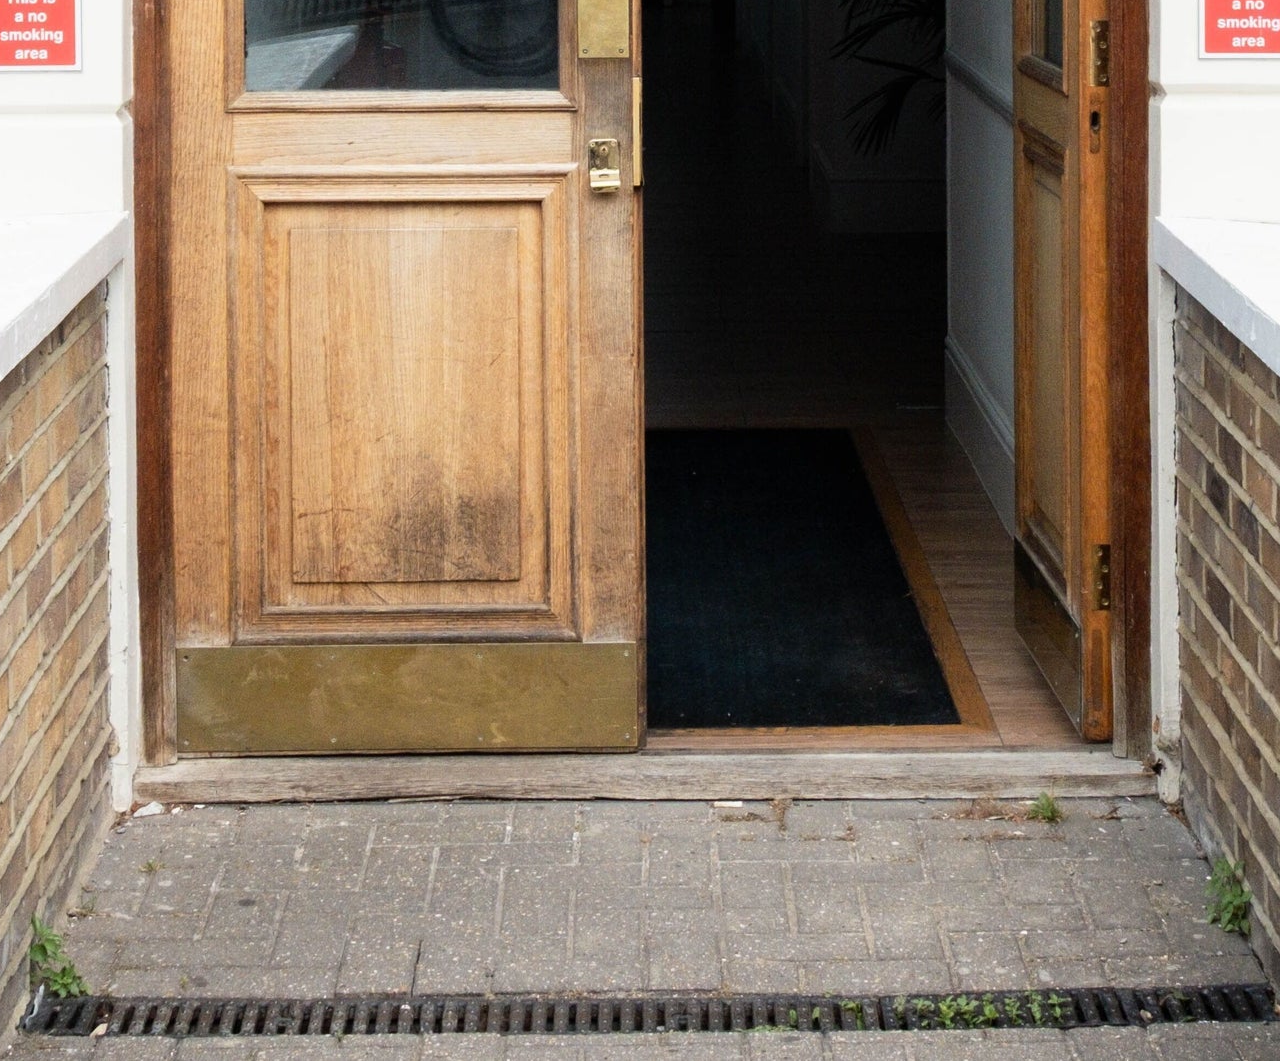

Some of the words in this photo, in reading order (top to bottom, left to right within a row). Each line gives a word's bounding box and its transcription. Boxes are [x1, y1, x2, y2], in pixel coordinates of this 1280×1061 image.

[1232, 0, 1241, 10] a
[1245, 0, 1265, 10] no
[14, 12, 23, 23] a
[28, 12, 47, 23] no
[1217, 16, 1280, 32] smoking
[0, 28, 63, 44] smoking
[1232, 36, 1265, 47] area
[15, 49, 48, 60] area
